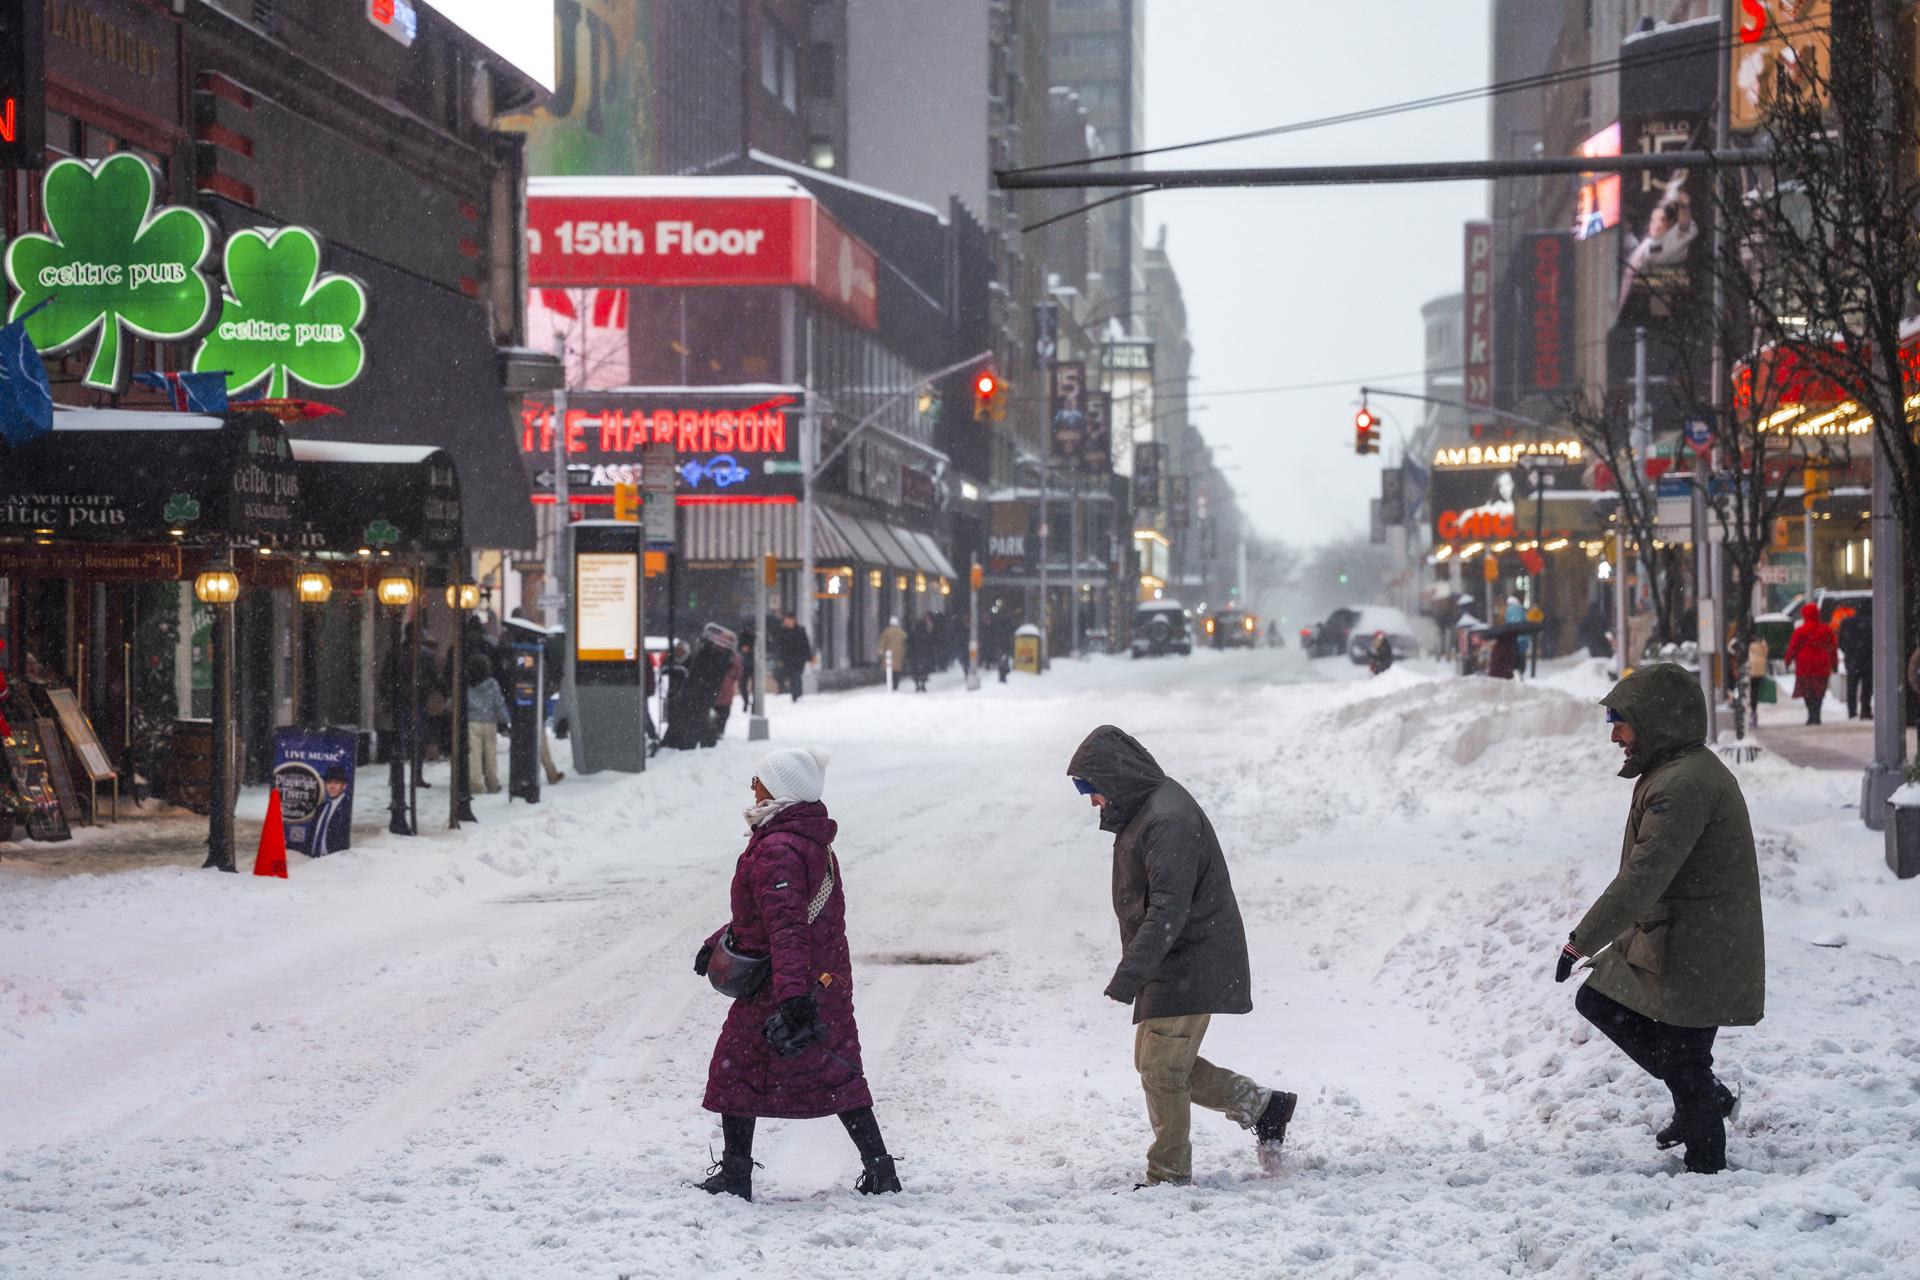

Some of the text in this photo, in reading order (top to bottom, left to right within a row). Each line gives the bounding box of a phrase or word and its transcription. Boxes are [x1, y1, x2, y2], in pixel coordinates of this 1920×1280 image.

[43, 0, 160, 81] LAYWRIGHT
[555, 221, 645, 255] 15th
[656, 221, 764, 255] Floor
[601, 409, 787, 453] HARRISON
[85, 554, 139, 568] Restaurant
[284, 750, 341, 762] LIVE MUSIC
